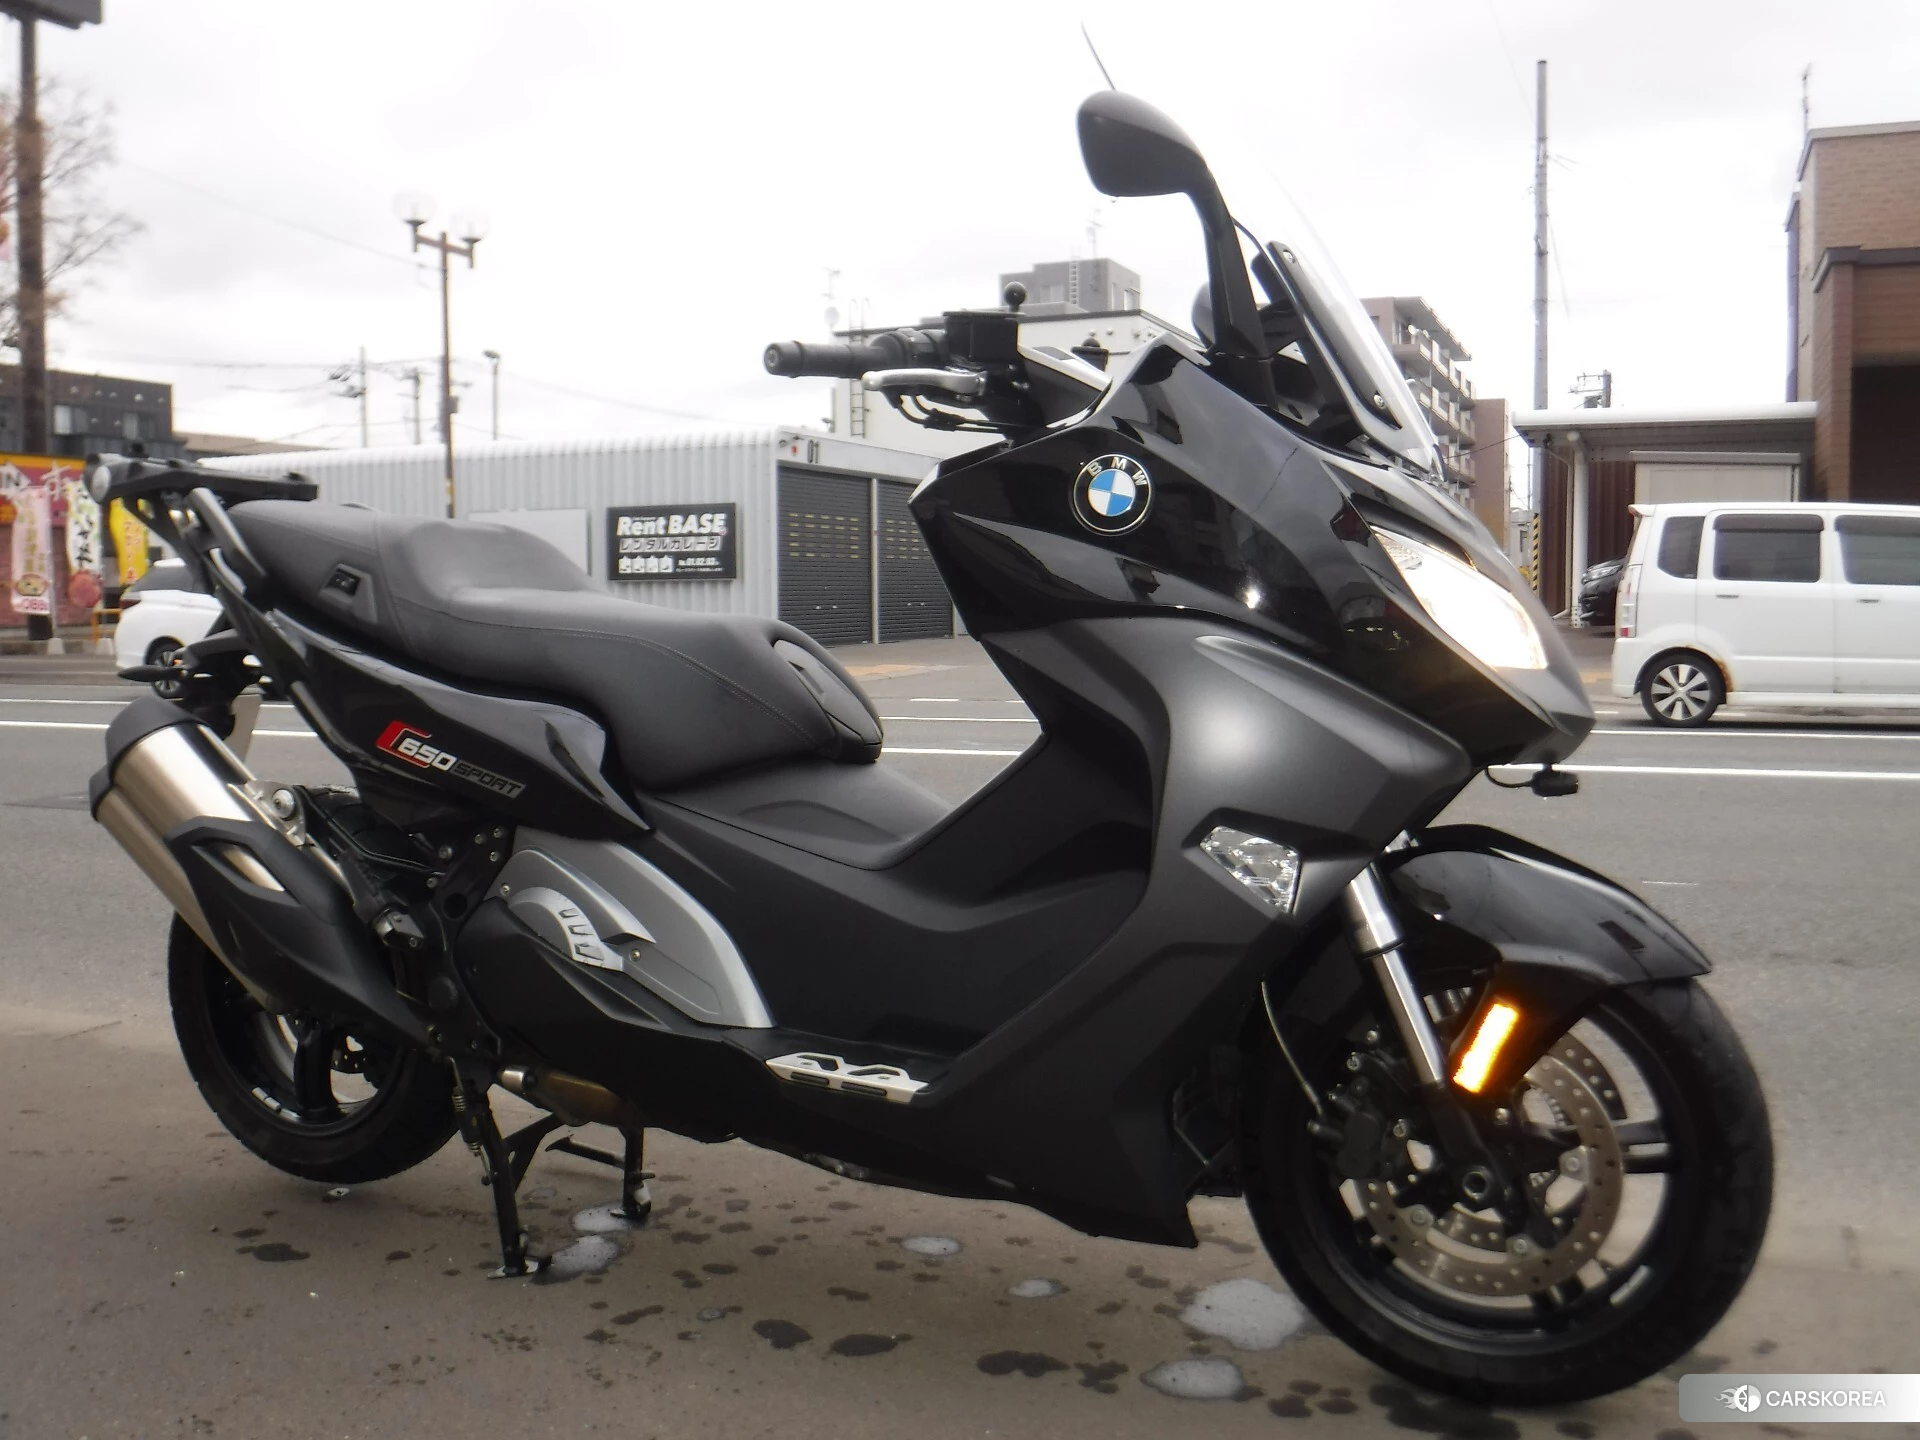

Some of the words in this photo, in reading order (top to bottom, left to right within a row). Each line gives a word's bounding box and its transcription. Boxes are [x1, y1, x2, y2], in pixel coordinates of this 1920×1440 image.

[1087, 456, 1147, 486] BMW
[617, 516, 666, 536] Rent
[668, 513, 726, 535] BASE
[452, 761, 524, 796] SPORT
